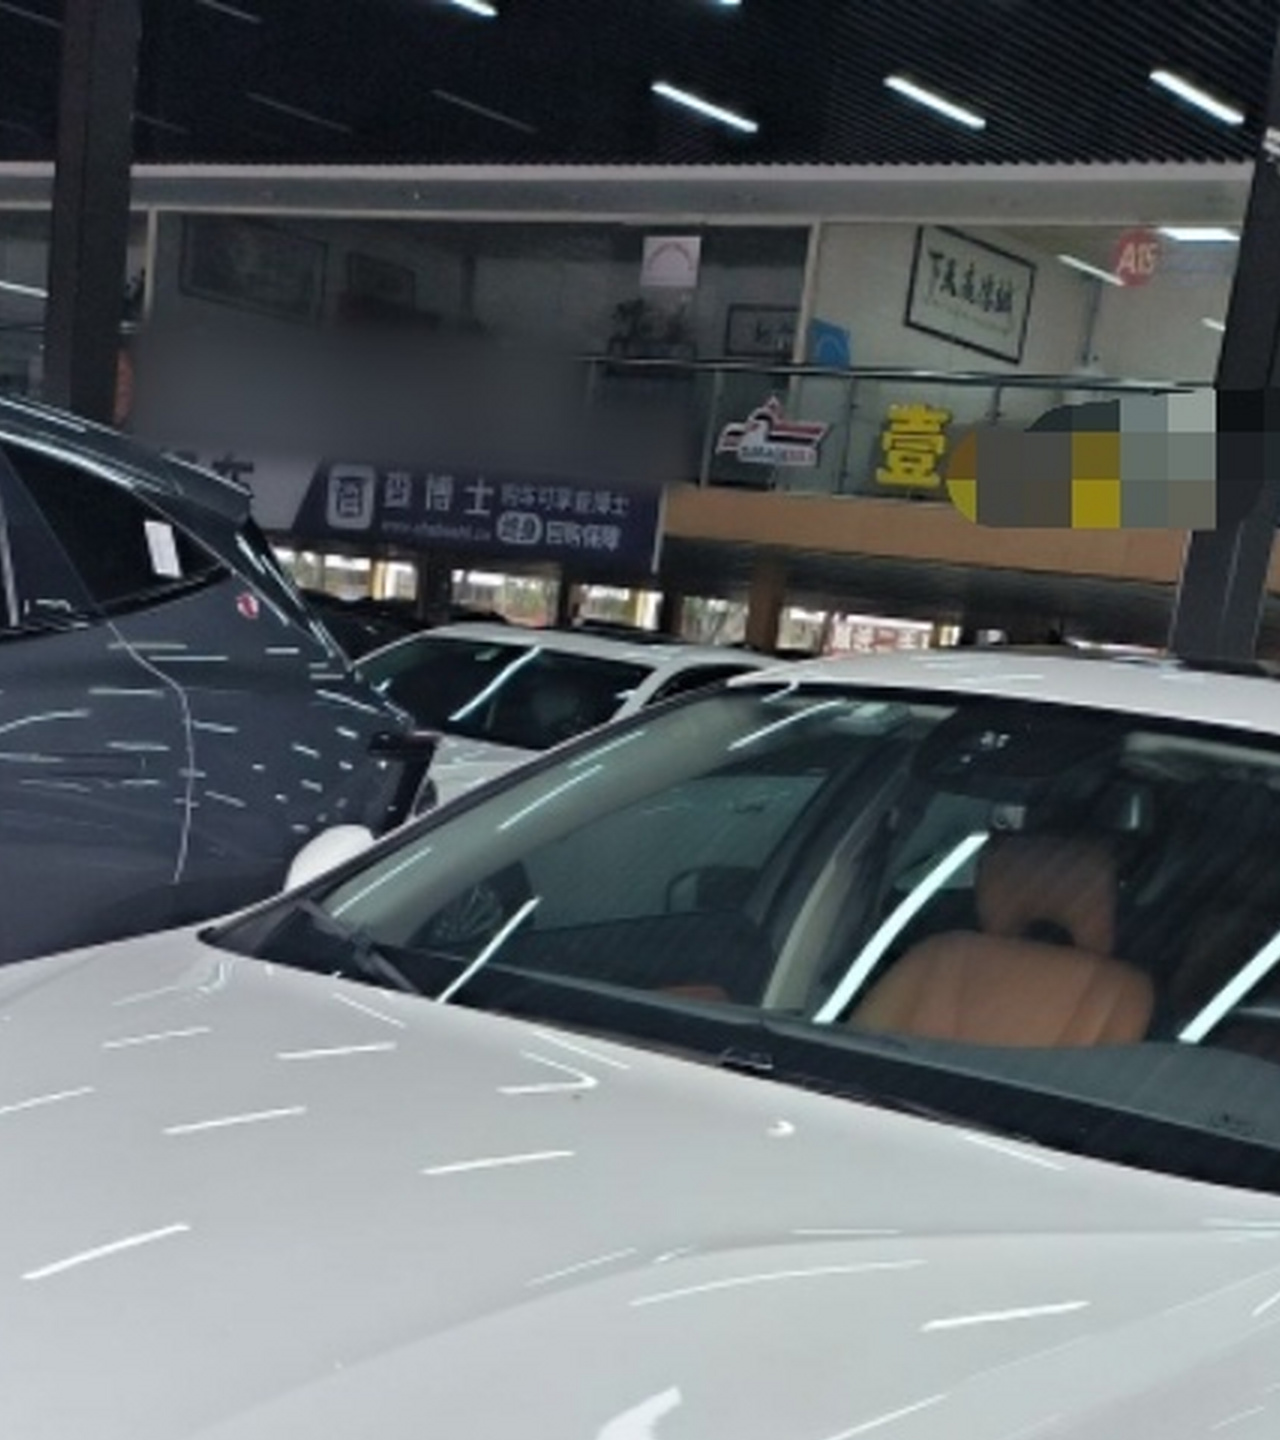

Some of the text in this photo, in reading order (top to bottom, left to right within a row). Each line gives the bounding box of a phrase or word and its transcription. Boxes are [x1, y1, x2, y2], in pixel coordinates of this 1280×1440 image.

[876, 403, 954, 489] 壹
[384, 472, 494, 515] 查博士
